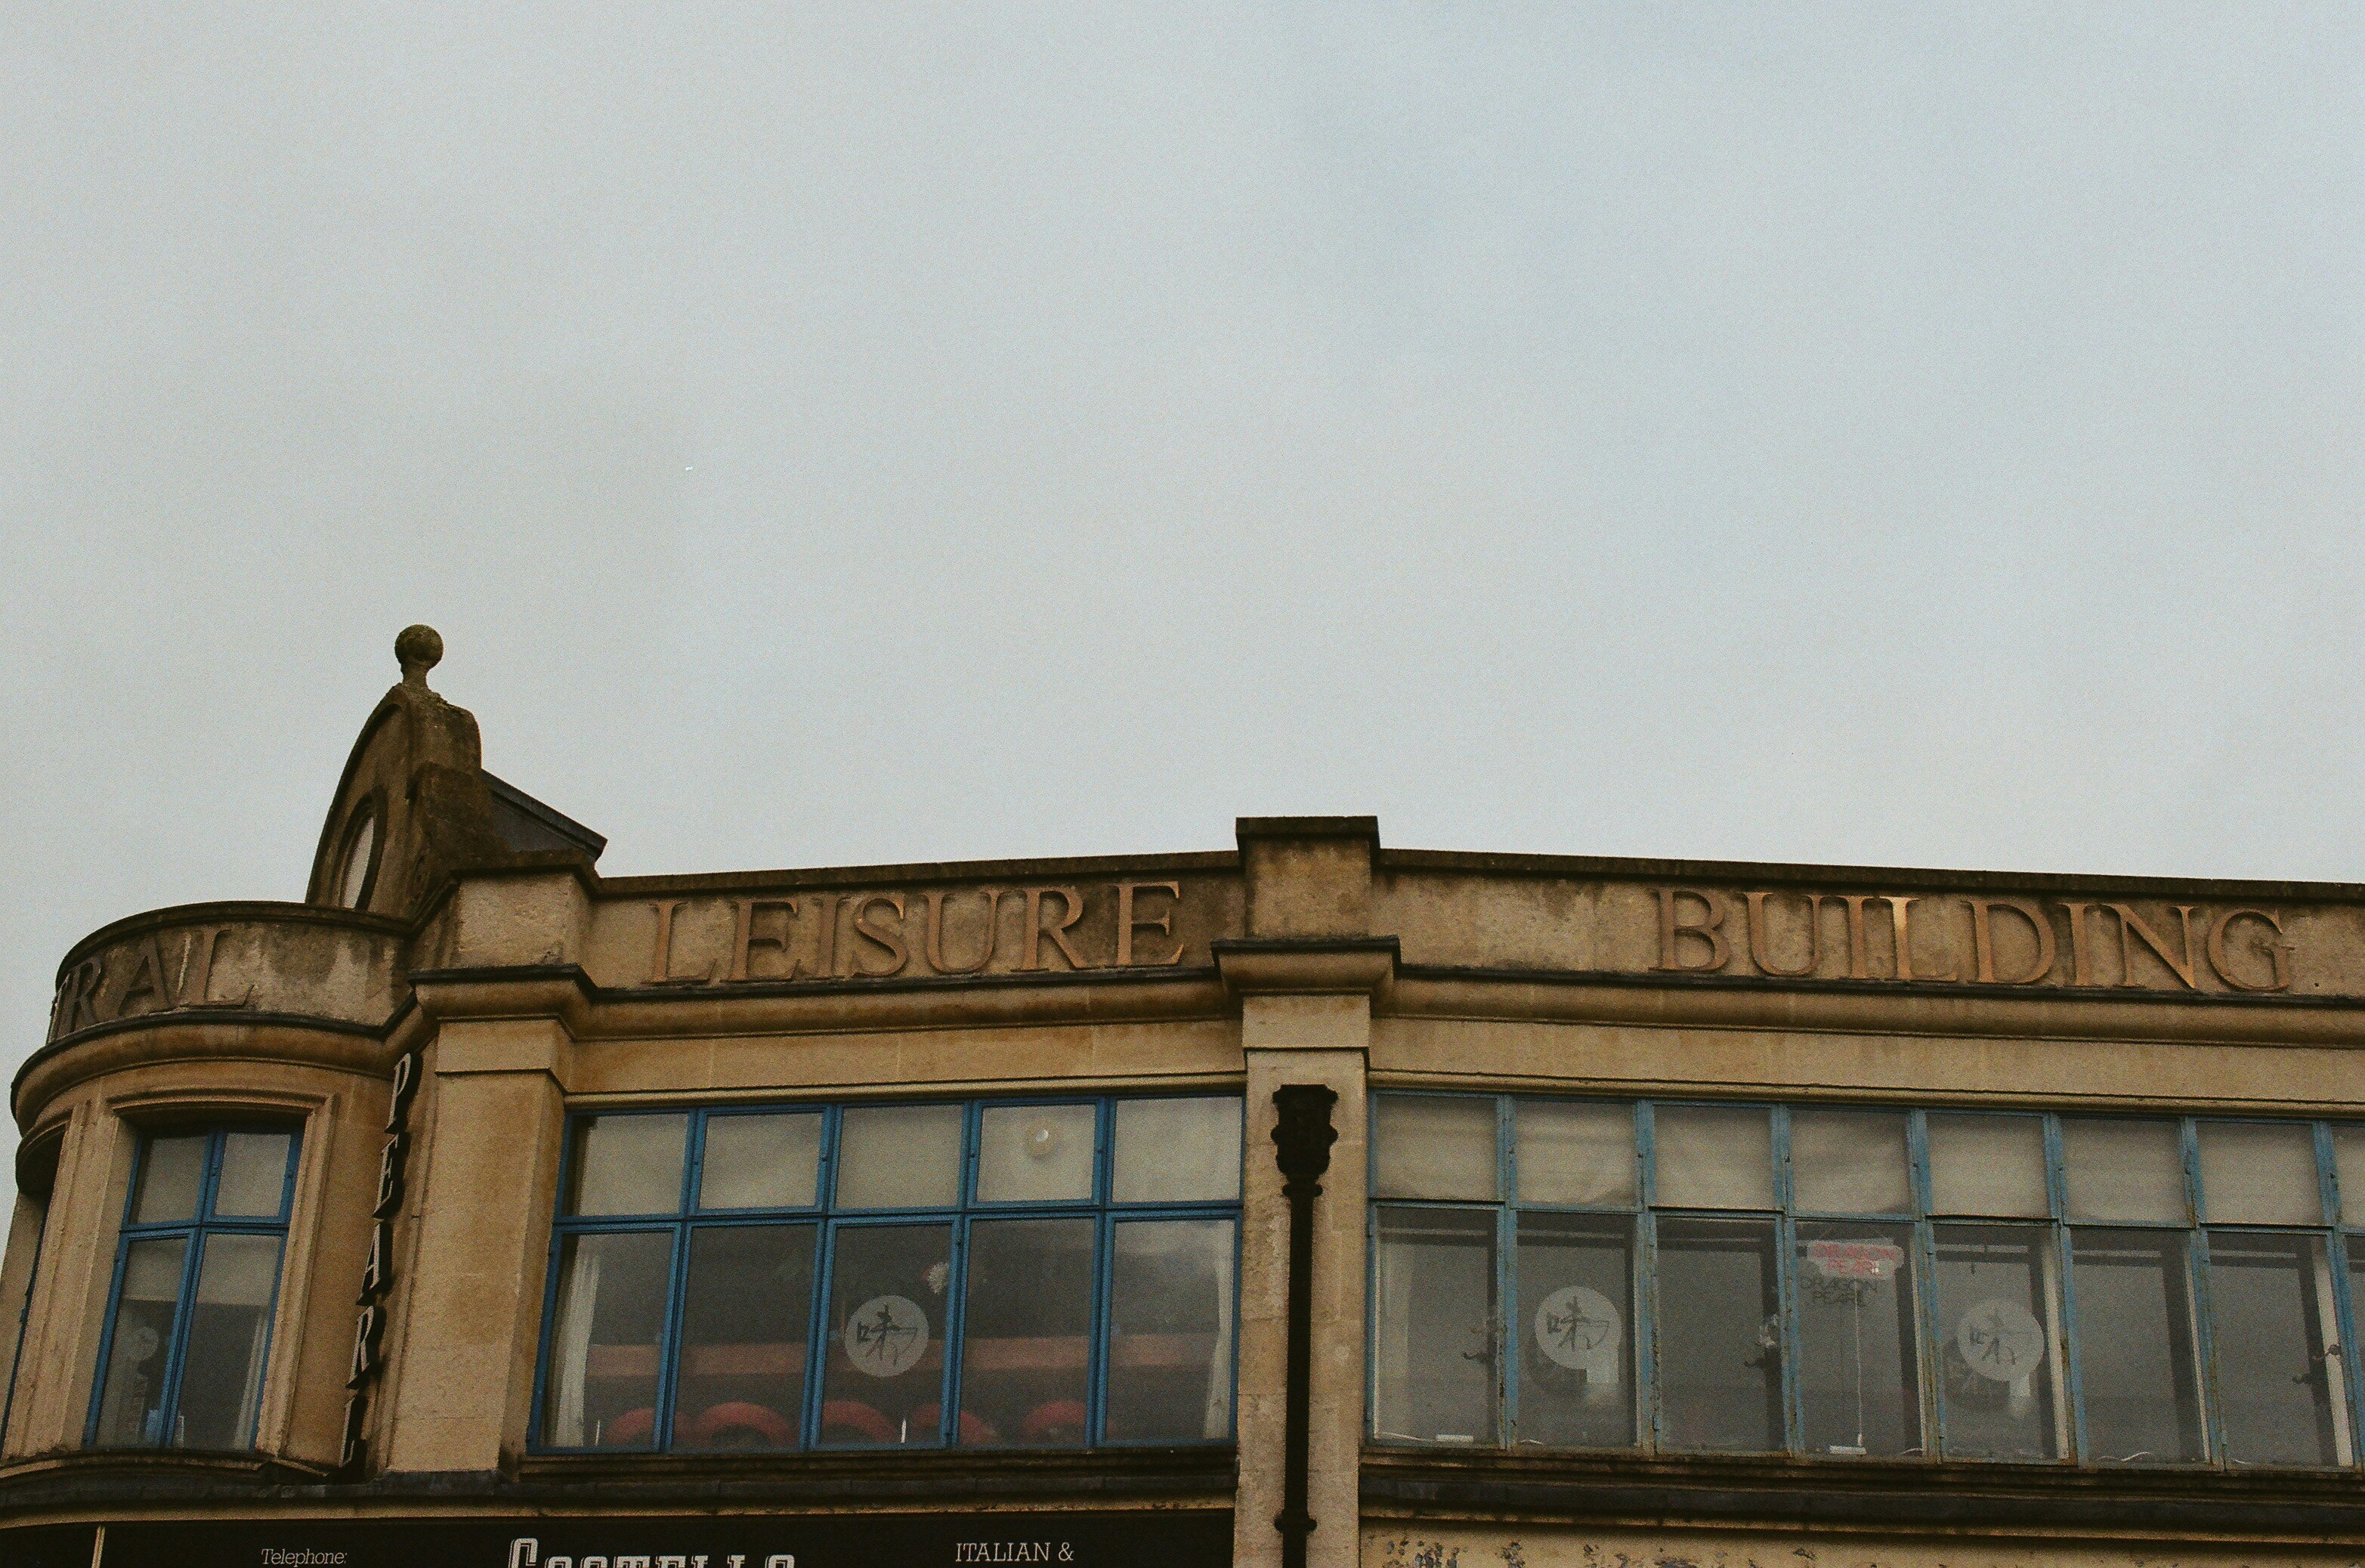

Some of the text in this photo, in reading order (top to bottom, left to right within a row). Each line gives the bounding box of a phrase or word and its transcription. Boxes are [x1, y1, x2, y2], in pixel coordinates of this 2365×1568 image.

[641, 880, 2296, 992] LEISURE BUILDING
[337, 1052, 414, 1469] PEARL
[1814, 1242, 1898, 1261] DRAGON
[261, 1548, 348, 1567] Telephone:
[955, 1542, 1074, 1562] ITALIAN &
